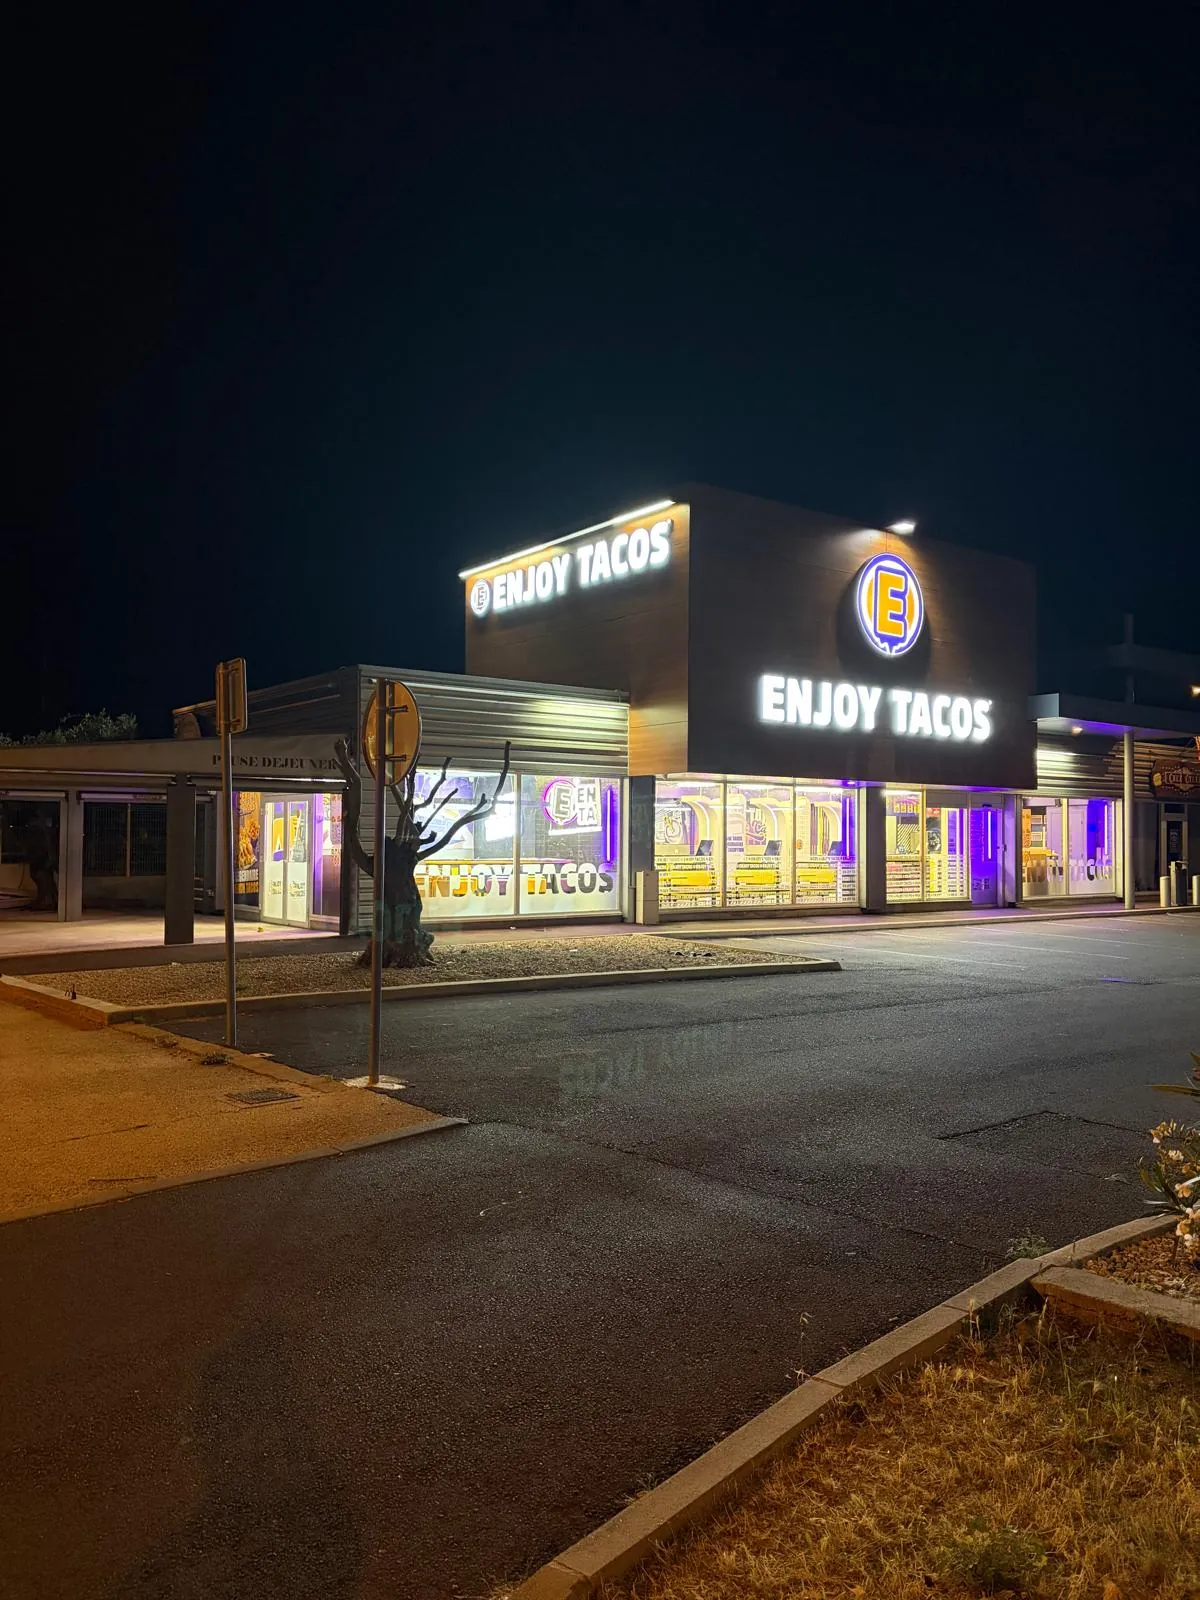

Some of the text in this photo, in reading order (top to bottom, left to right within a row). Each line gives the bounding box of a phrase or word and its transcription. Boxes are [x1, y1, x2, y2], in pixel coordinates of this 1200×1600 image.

[493, 553, 570, 611] ENJOY
[577, 521, 671, 586] TACOS
[876, 567, 906, 639] E
[761, 674, 991, 740] ENJOY TACOS
[212, 754, 258, 767] PUSE
[521, 862, 613, 895] TACOS
